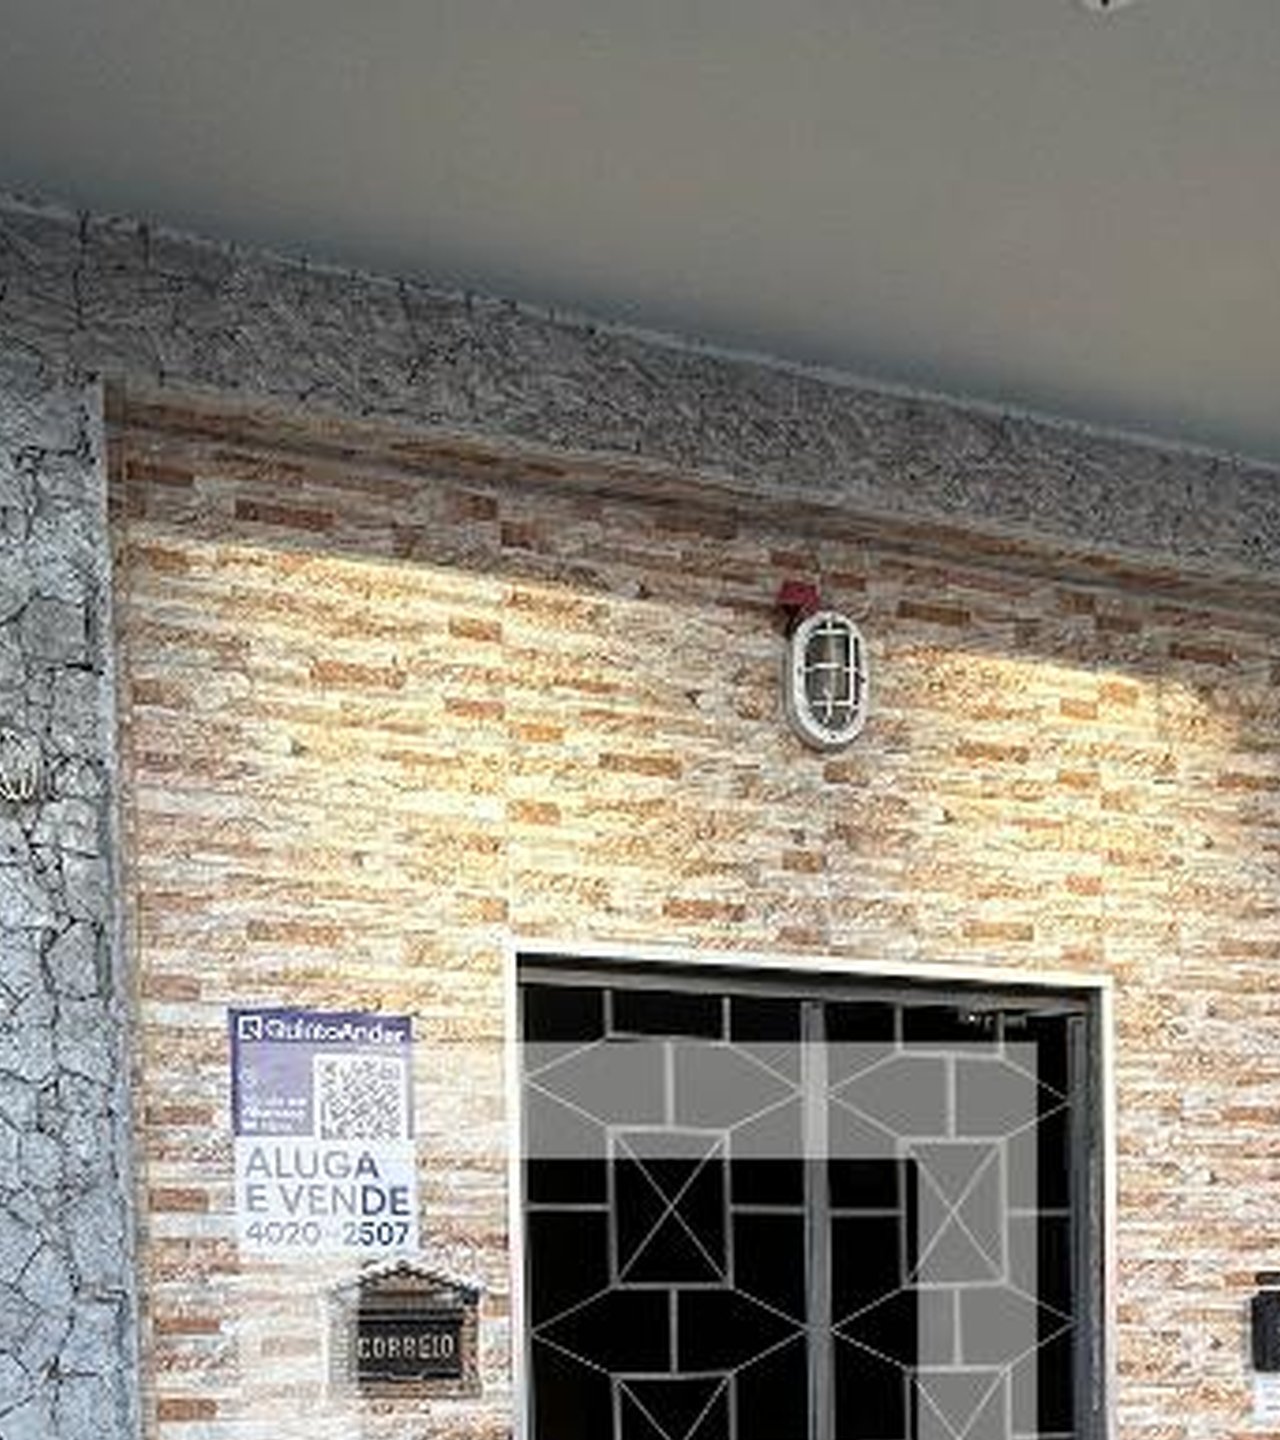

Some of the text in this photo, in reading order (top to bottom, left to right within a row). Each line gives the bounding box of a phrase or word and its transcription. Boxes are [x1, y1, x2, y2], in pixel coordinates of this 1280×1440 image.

[245, 1146, 381, 1179] ALUGA
[246, 1184, 412, 1217] E VENDE
[358, 1334, 455, 1358] CORREIO
